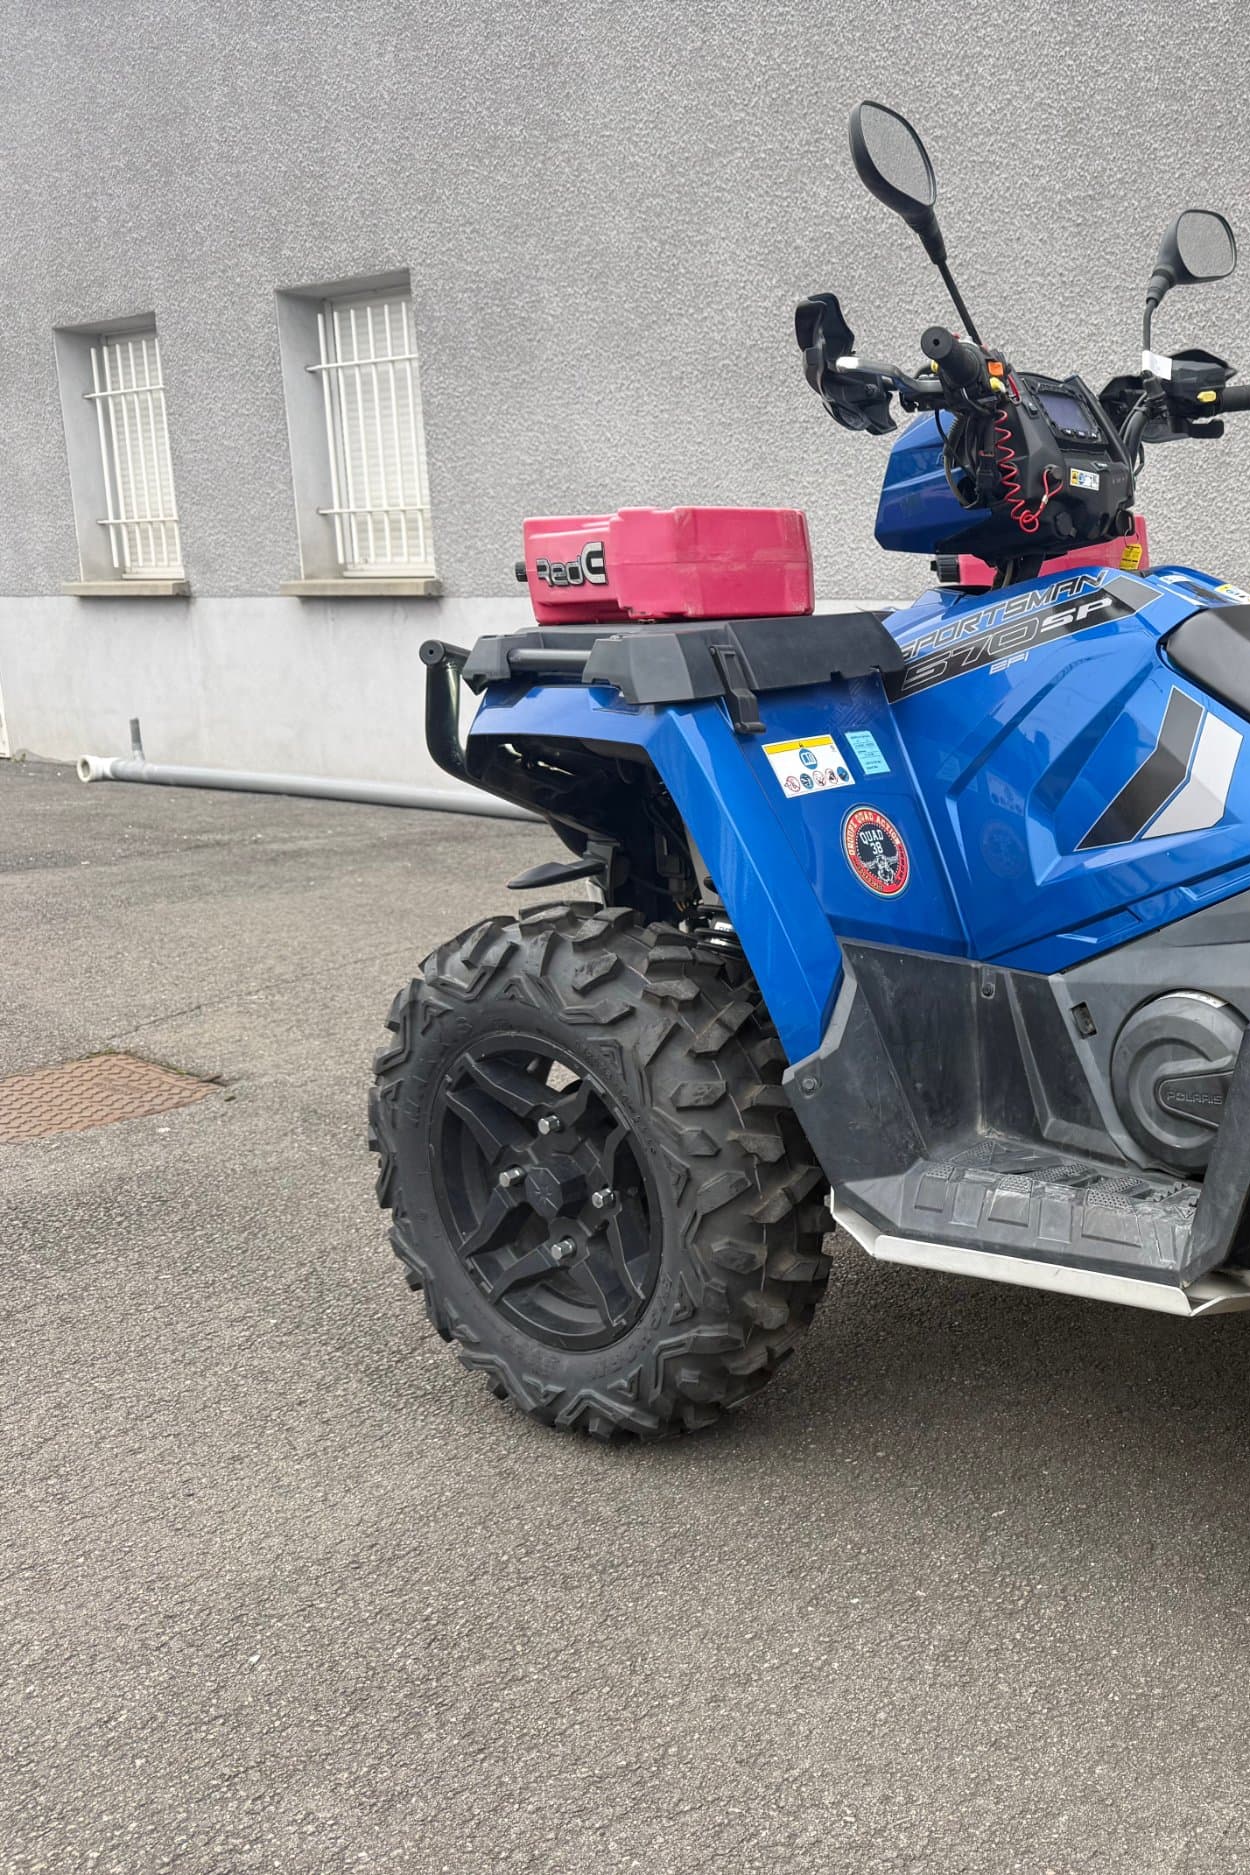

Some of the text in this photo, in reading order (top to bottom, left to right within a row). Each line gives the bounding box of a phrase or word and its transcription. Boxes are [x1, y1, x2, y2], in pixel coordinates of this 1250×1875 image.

[901, 597, 1112, 691] 570 SP
[988, 652, 1030, 675] EFI
[860, 829, 884, 845] QUAD
[870, 841, 883, 855] 38
[1166, 1091, 1223, 1105] POLARIS
